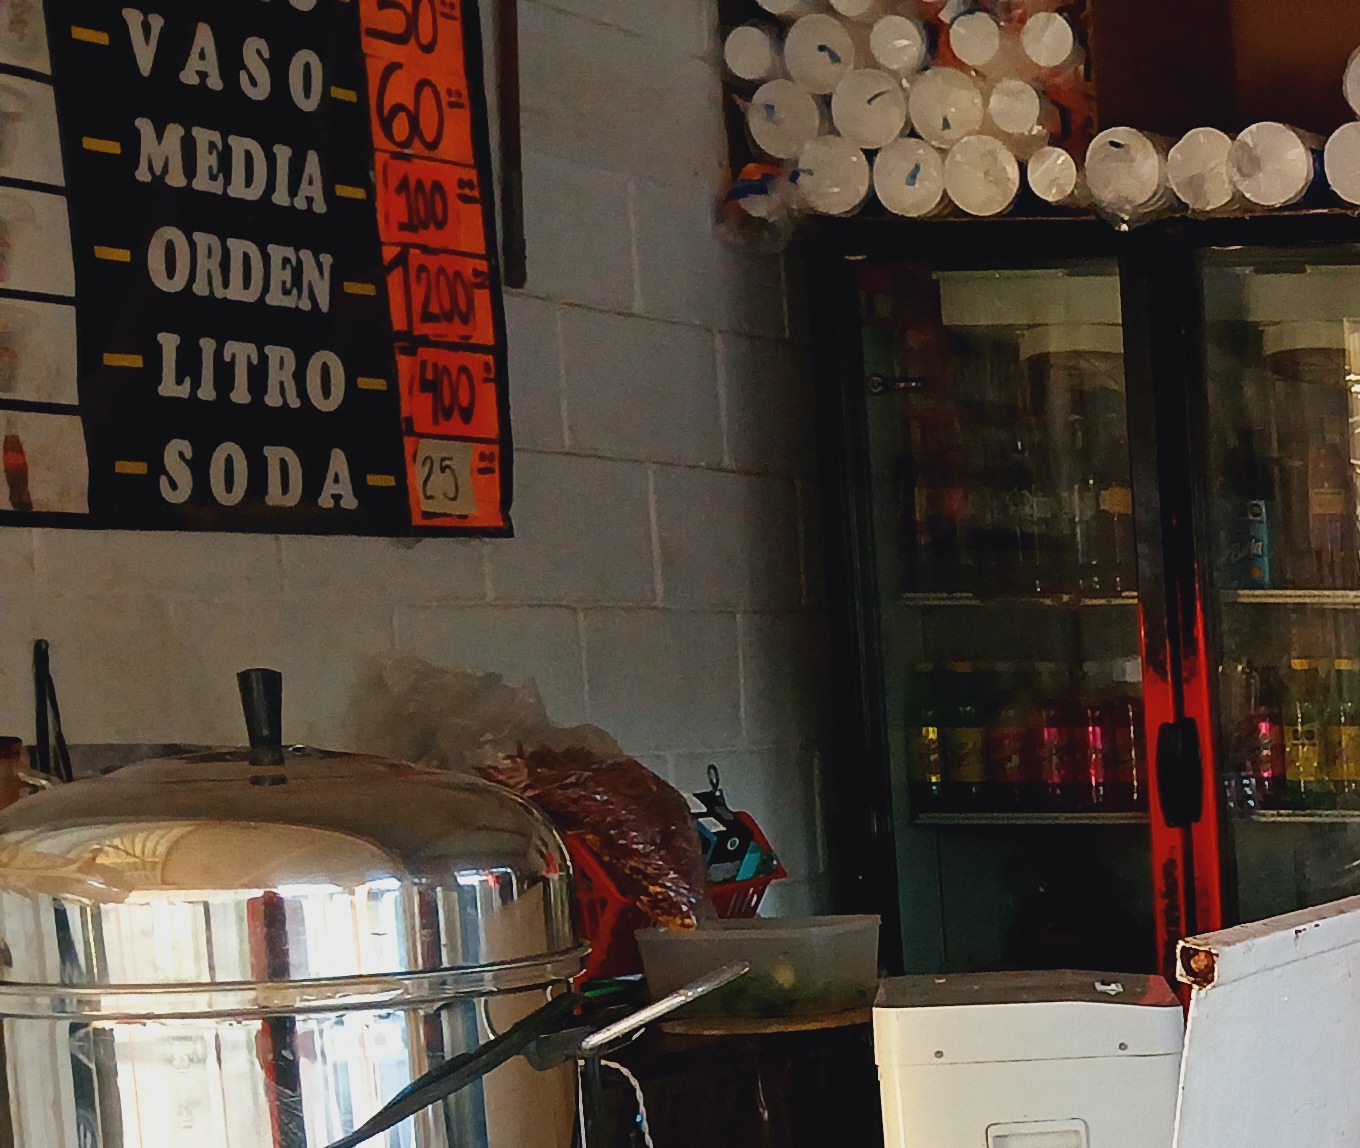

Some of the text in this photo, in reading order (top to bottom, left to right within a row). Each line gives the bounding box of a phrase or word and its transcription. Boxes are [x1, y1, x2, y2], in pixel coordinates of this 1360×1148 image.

[123, 8, 324, 112] VASO
[375, 61, 444, 151] 60
[135, 118, 328, 214] MEDIA
[395, 175, 448, 234] 100
[148, 226, 334, 313] ORDEN
[415, 263, 475, 326] 200
[156, 333, 346, 412] LITRO
[418, 359, 475, 425] 400
[159, 439, 358, 508] SODA
[422, 455, 459, 501] 25
